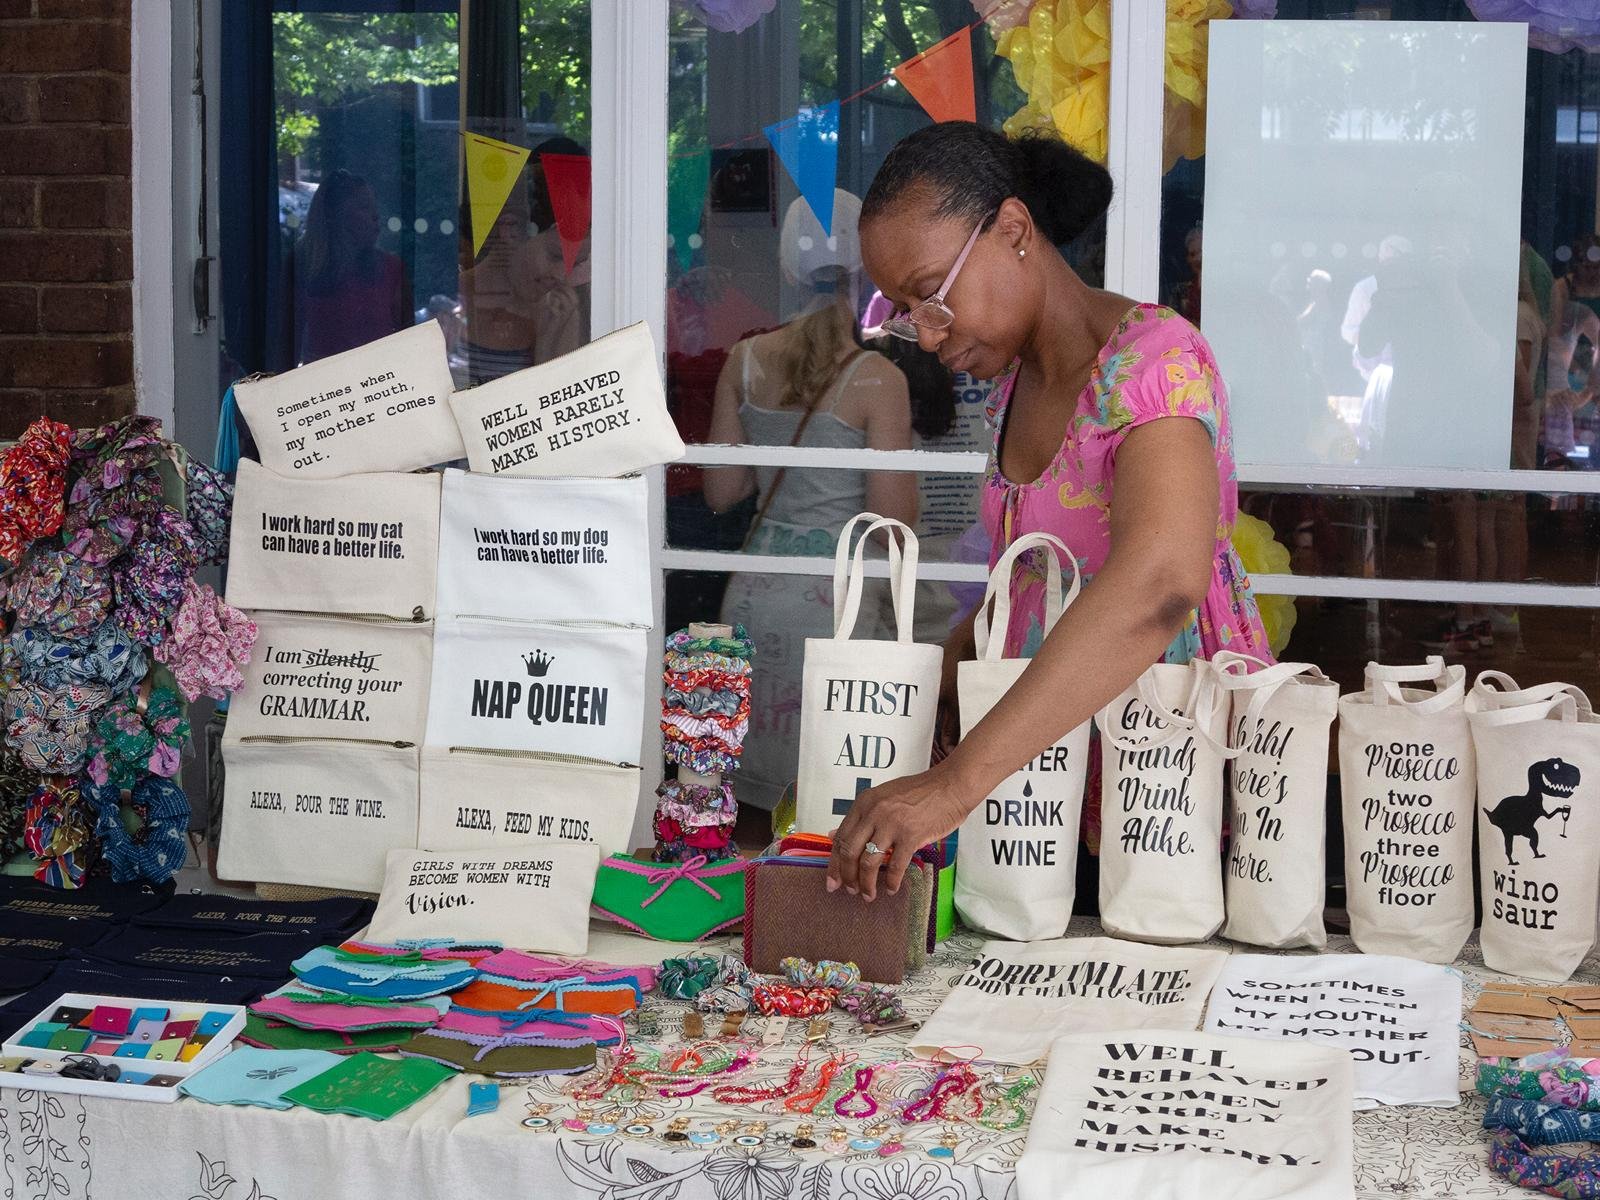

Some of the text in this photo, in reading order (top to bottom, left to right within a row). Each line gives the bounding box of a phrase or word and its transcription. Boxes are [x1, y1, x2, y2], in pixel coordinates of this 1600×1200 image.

[277, 371, 395, 417] Sometimes when
[281, 382, 414, 432] I open my mouth,
[481, 370, 620, 430] WELL BEHAVED
[286, 395, 436, 451] my mother comes
[486, 388, 624, 451] WOMEN RARELY
[491, 409, 641, 473] MAKE HISTORY.
[293, 451, 330, 469] out.
[262, 513, 403, 539] I work hard so my cat
[473, 528, 609, 546] I work hard so my dog
[262, 535, 405, 559] can have a better life.
[477, 545, 608, 564] can have a better life.
[264, 646, 380, 673] I am silently
[263, 671, 402, 695] correcting your
[260, 694, 370, 722] GRAMMAR.
[471, 679, 608, 726] NAP QUEEN
[823, 679, 918, 717] FIRST
[833, 733, 896, 769] AID
[1364, 743, 1460, 781] Prosecco
[1389, 742, 1435, 757] one
[250, 791, 386, 819] ALEXA, POUR THE WINE.
[1118, 777, 1195, 816] Drink
[1388, 789, 1432, 807] two
[456, 807, 594, 842] ALEXA, FEED MY KIDS.
[985, 799, 1064, 827] DRINK
[1256, 806, 1284, 841] In
[1361, 797, 1457, 835] Prosecco
[1120, 815, 1195, 857] Alike.
[1377, 838, 1440, 858] three
[412, 861, 553, 872] GIRLS WITH DREAMS
[990, 839, 1056, 867] WINE
[408, 873, 551, 888] BECOME WOMEN WITH
[1360, 850, 1455, 887] Prosecco
[1378, 886, 1436, 906] floor
[1493, 869, 1558, 903] wino
[404, 892, 475, 915] Vision.
[1493, 898, 1557, 930] saur
[235, 912, 262, 921] POUR
[265, 914, 287, 923] THE
[1226, 987, 1308, 1004] WHEN
[1243, 980, 1406, 997] SOMETIMES
[1234, 1006, 1278, 1019] MY
[1282, 1027, 1429, 1041] MOTHER
[1104, 1043, 1235, 1069] WELL
[1097, 1067, 1328, 1091] BEHAVED
[1090, 1085, 1281, 1109] WOMEN
[1080, 1118, 1225, 1140] MAKE
